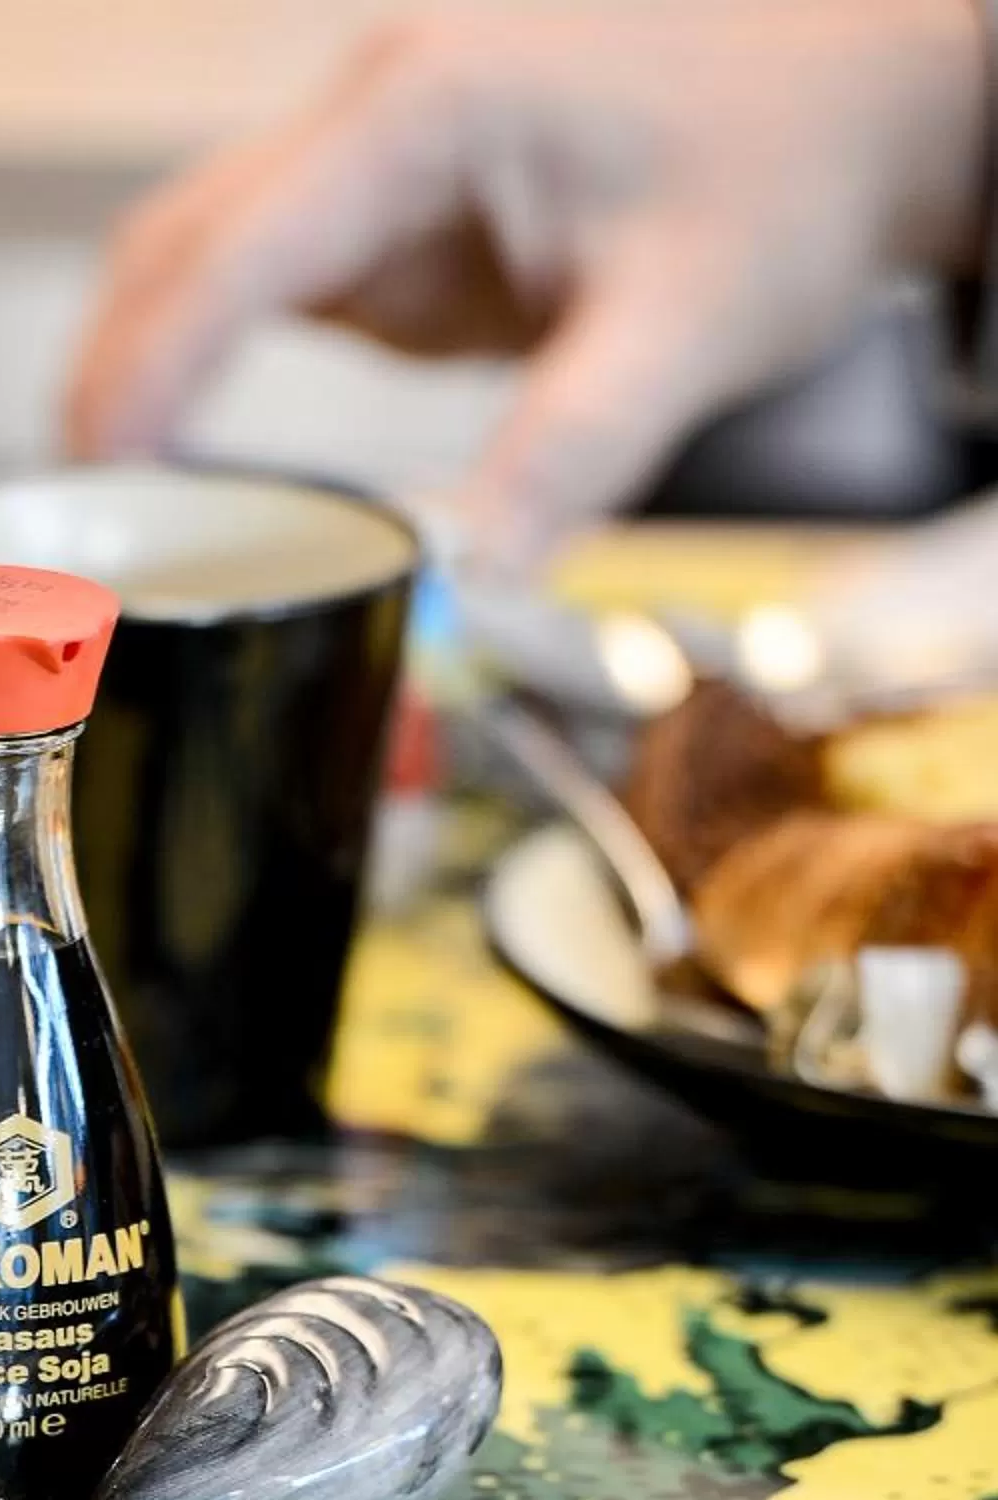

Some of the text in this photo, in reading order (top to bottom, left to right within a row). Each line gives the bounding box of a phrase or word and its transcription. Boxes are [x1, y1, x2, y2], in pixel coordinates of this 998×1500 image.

[13, 1292, 119, 1320] GEBROUWEN
[37, 1350, 111, 1384] Soja
[35, 1378, 128, 1406] NATURELLE
[10, 1415, 36, 1438] ml
